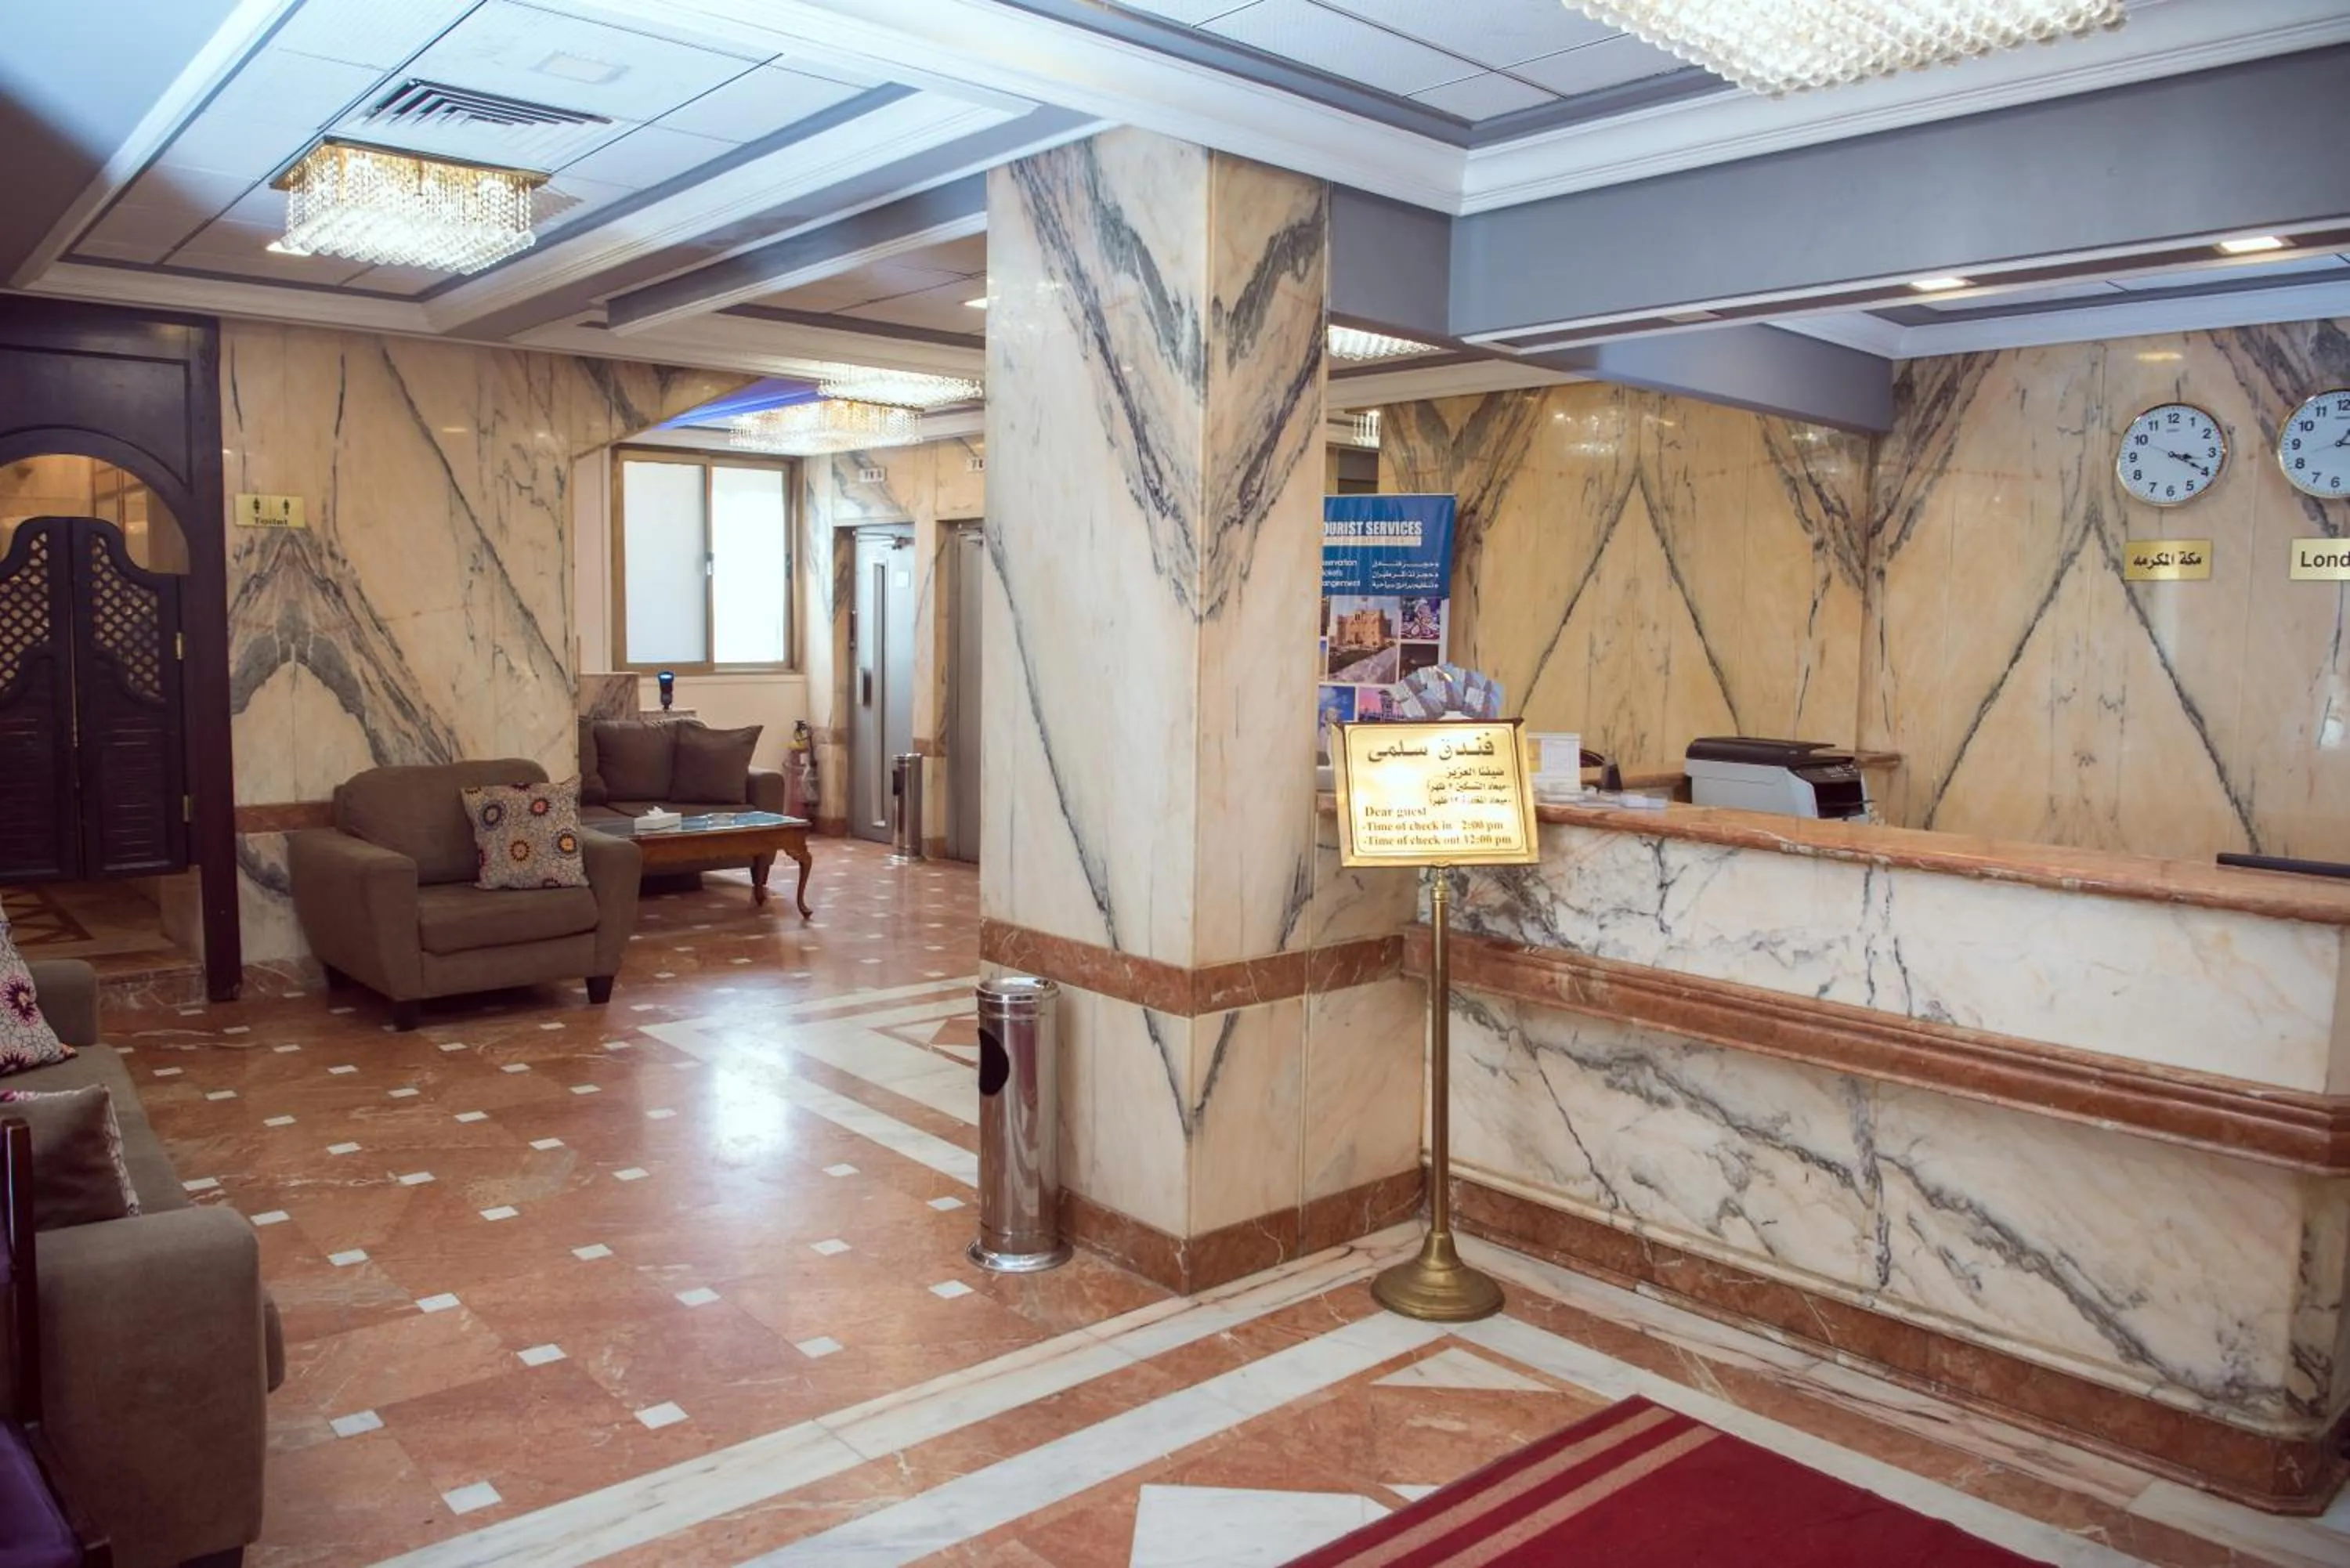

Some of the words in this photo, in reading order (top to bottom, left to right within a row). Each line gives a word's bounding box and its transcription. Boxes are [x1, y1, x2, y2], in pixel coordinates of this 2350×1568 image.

[2315, 406, 2327, 417] 11
[2167, 412, 2180, 424] 12
[2190, 417, 2196, 426] 1
[2148, 420, 2158, 431] 11
[2298, 421, 2315, 432] 10
[2203, 428, 2211, 439] 2
[2135, 435, 2148, 445] 10
[2291, 439, 2301, 450] 9
[2128, 452, 2138, 462] 9
[2207, 447, 2216, 458] 3
[2295, 458, 2305, 469] 8
[2133, 470, 2142, 480] 8
[2200, 467, 2209, 476] 4
[2312, 472, 2322, 483] 7
[2330, 477, 2341, 488] 6
[2149, 482, 2157, 493] 7
[2186, 480, 2194, 491] 5
[2166, 486, 2175, 497] 6
[1365, 521, 1422, 535] SERVICES
[2179, 551, 2202, 565] مكة
[1368, 739, 1428, 762] سلمى
[1439, 732, 1495, 761] فندق
[1447, 767, 1476, 779] العزيز
[1478, 767, 1505, 779] ضيفنا
[1365, 806, 1392, 817] Dear
[1397, 807, 1426, 818] guest
[1395, 822, 1406, 831] of
[1409, 821, 1438, 831] check
[1442, 820, 1452, 829] in
[1462, 820, 1484, 829] 2:00
[1486, 822, 1503, 832] pm
[1397, 836, 1408, 845] of
[1410, 835, 1441, 845] check
[1444, 835, 1460, 844] out
[1464, 834, 1492, 844] 12:00
[1495, 836, 1512, 846] pm
